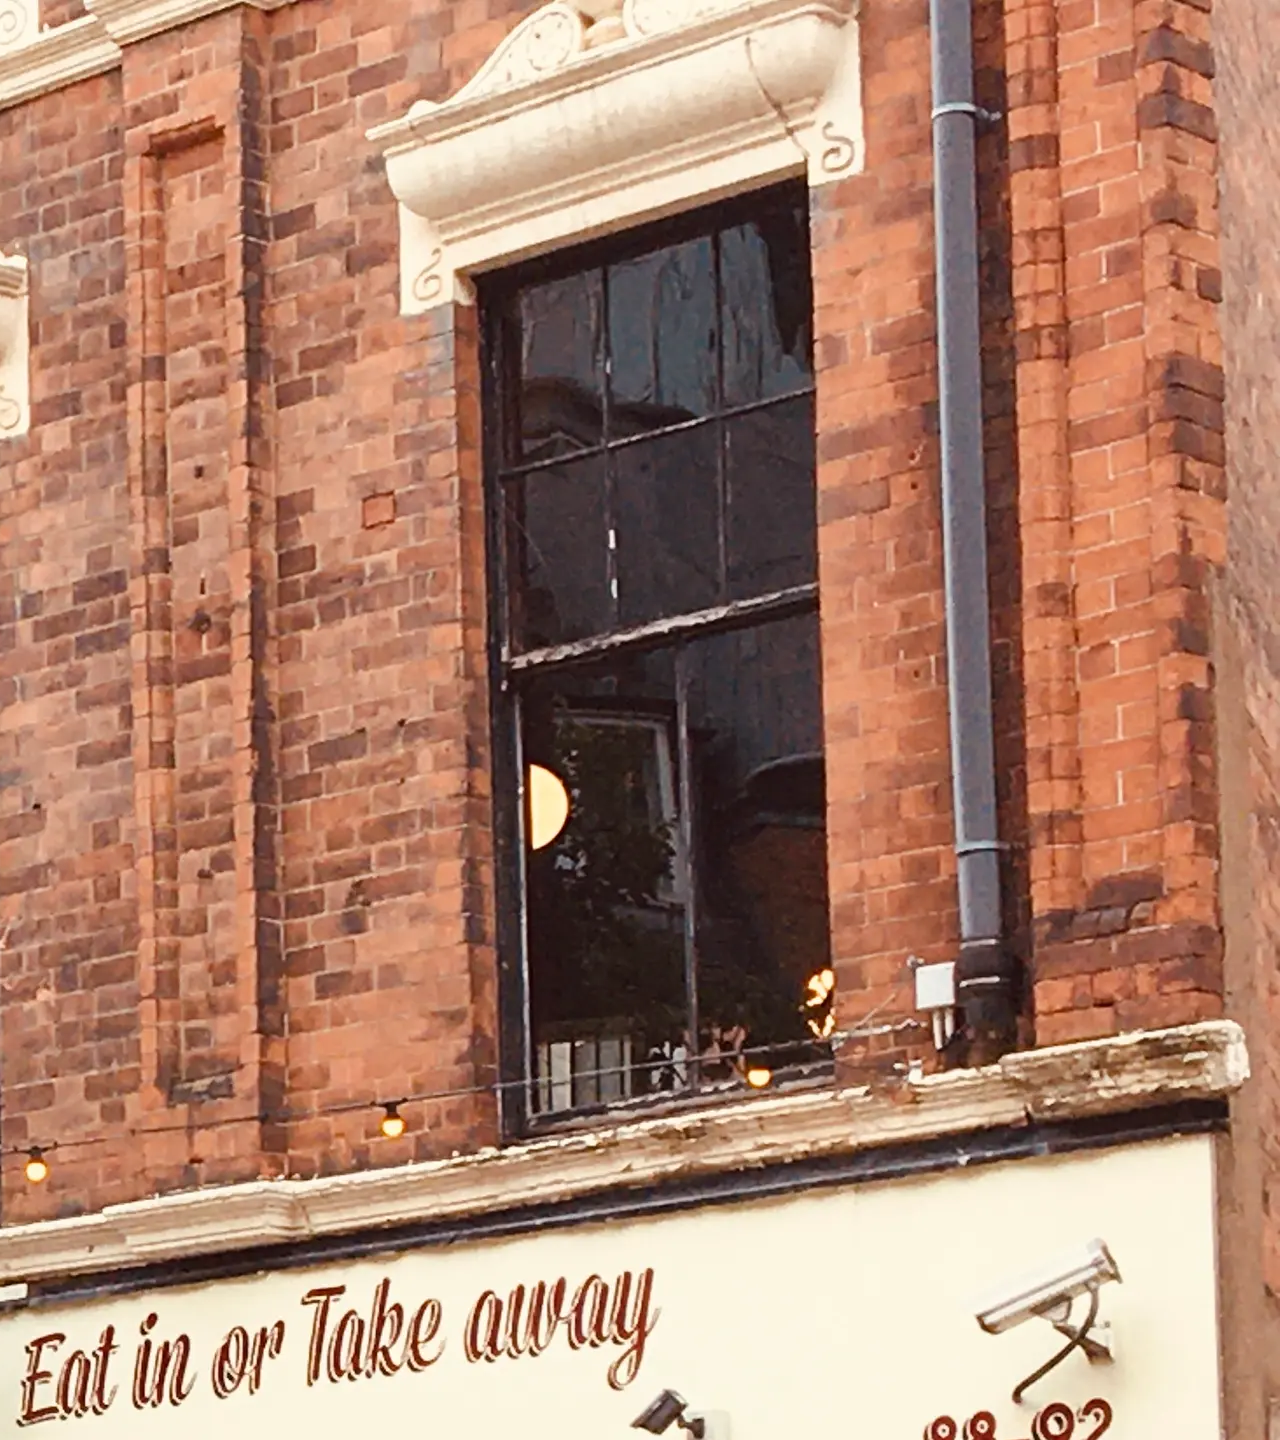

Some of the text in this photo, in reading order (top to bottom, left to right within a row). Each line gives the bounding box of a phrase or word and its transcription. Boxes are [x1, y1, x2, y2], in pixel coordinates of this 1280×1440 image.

[16, 1267, 662, 1428] Eat in or Take away
